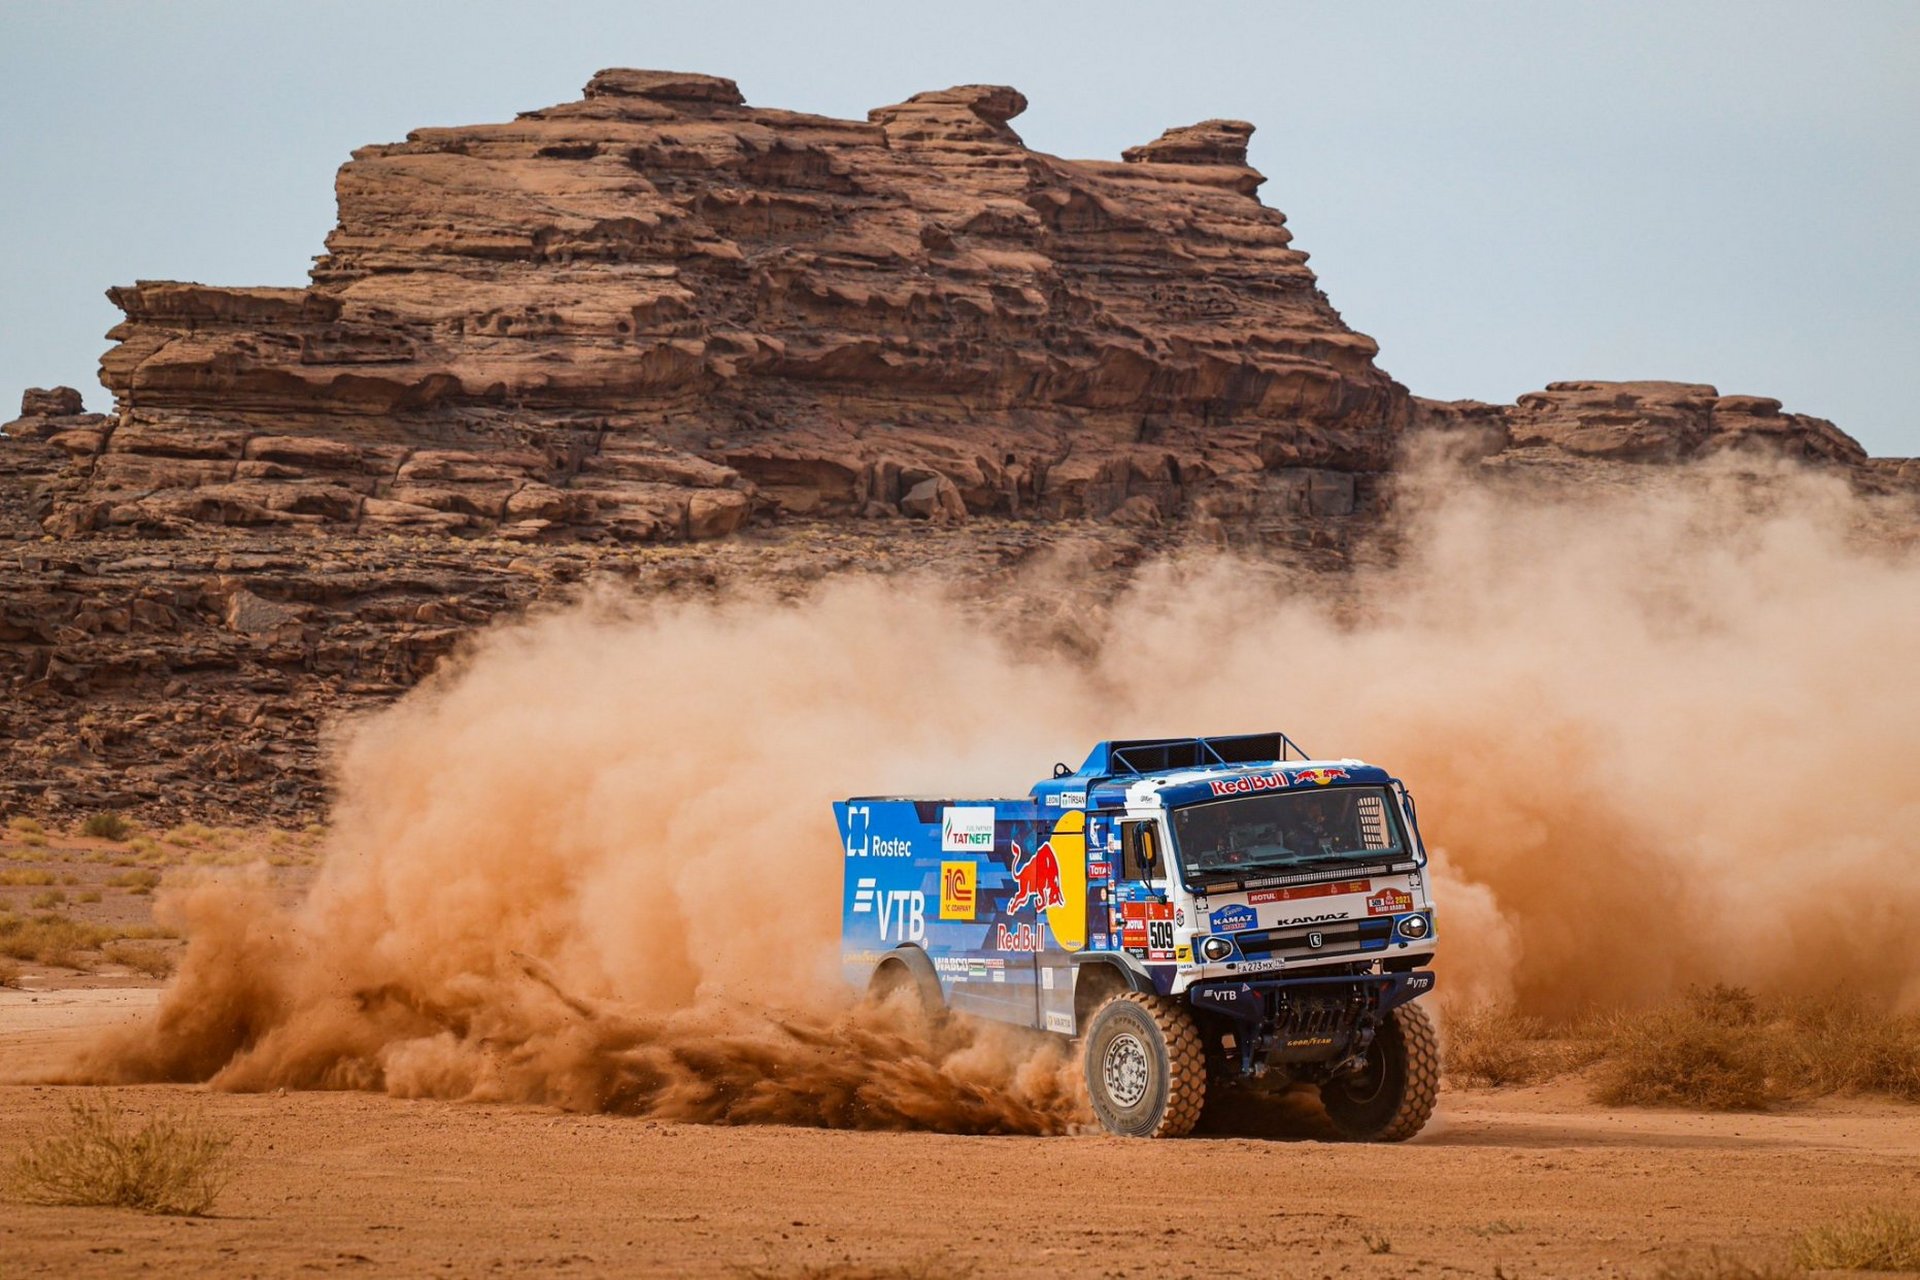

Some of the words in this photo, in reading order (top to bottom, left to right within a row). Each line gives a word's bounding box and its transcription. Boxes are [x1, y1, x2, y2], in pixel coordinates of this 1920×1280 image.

[1209, 777, 1250, 796] Red
[1251, 772, 1289, 789] Bull
[953, 833, 992, 844] TATNEFT
[872, 835, 912, 857] Rostec
[1250, 892, 1277, 902] MOTUL
[1394, 895, 1411, 904] 2021
[876, 890, 926, 941] VTB
[1213, 914, 1253, 926] KAMAZ
[1277, 912, 1349, 926] KAMAZ
[996, 923, 1021, 951] Red
[1021, 924, 1045, 952] Bull
[1149, 921, 1174, 949] 509
[934, 957, 969, 972] WABCO
[1412, 978, 1428, 988] VTB
[1213, 991, 1237, 1001] VTB
